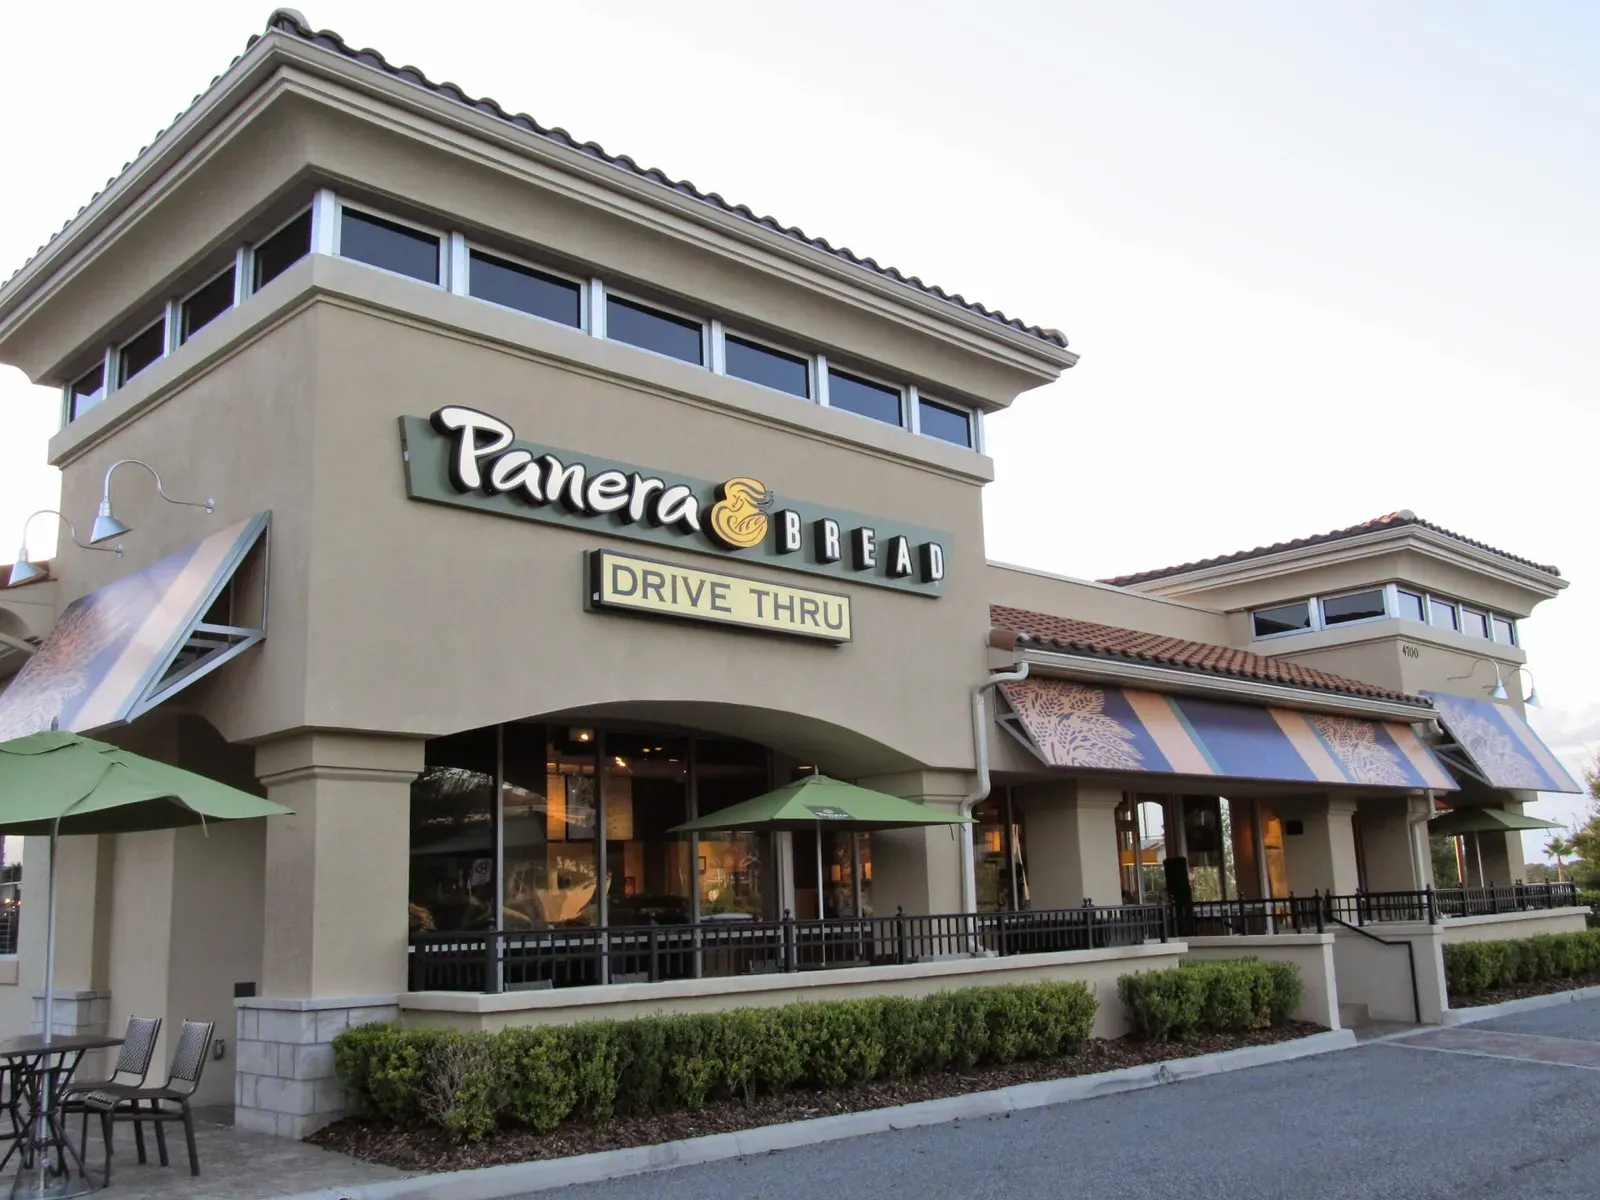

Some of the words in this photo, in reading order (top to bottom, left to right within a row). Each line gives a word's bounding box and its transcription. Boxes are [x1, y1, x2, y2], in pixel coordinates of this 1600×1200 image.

[432, 405, 700, 534] Panera
[777, 509, 944, 583] BREAD
[611, 563, 732, 613] DRIVE
[749, 587, 843, 630] THRU
